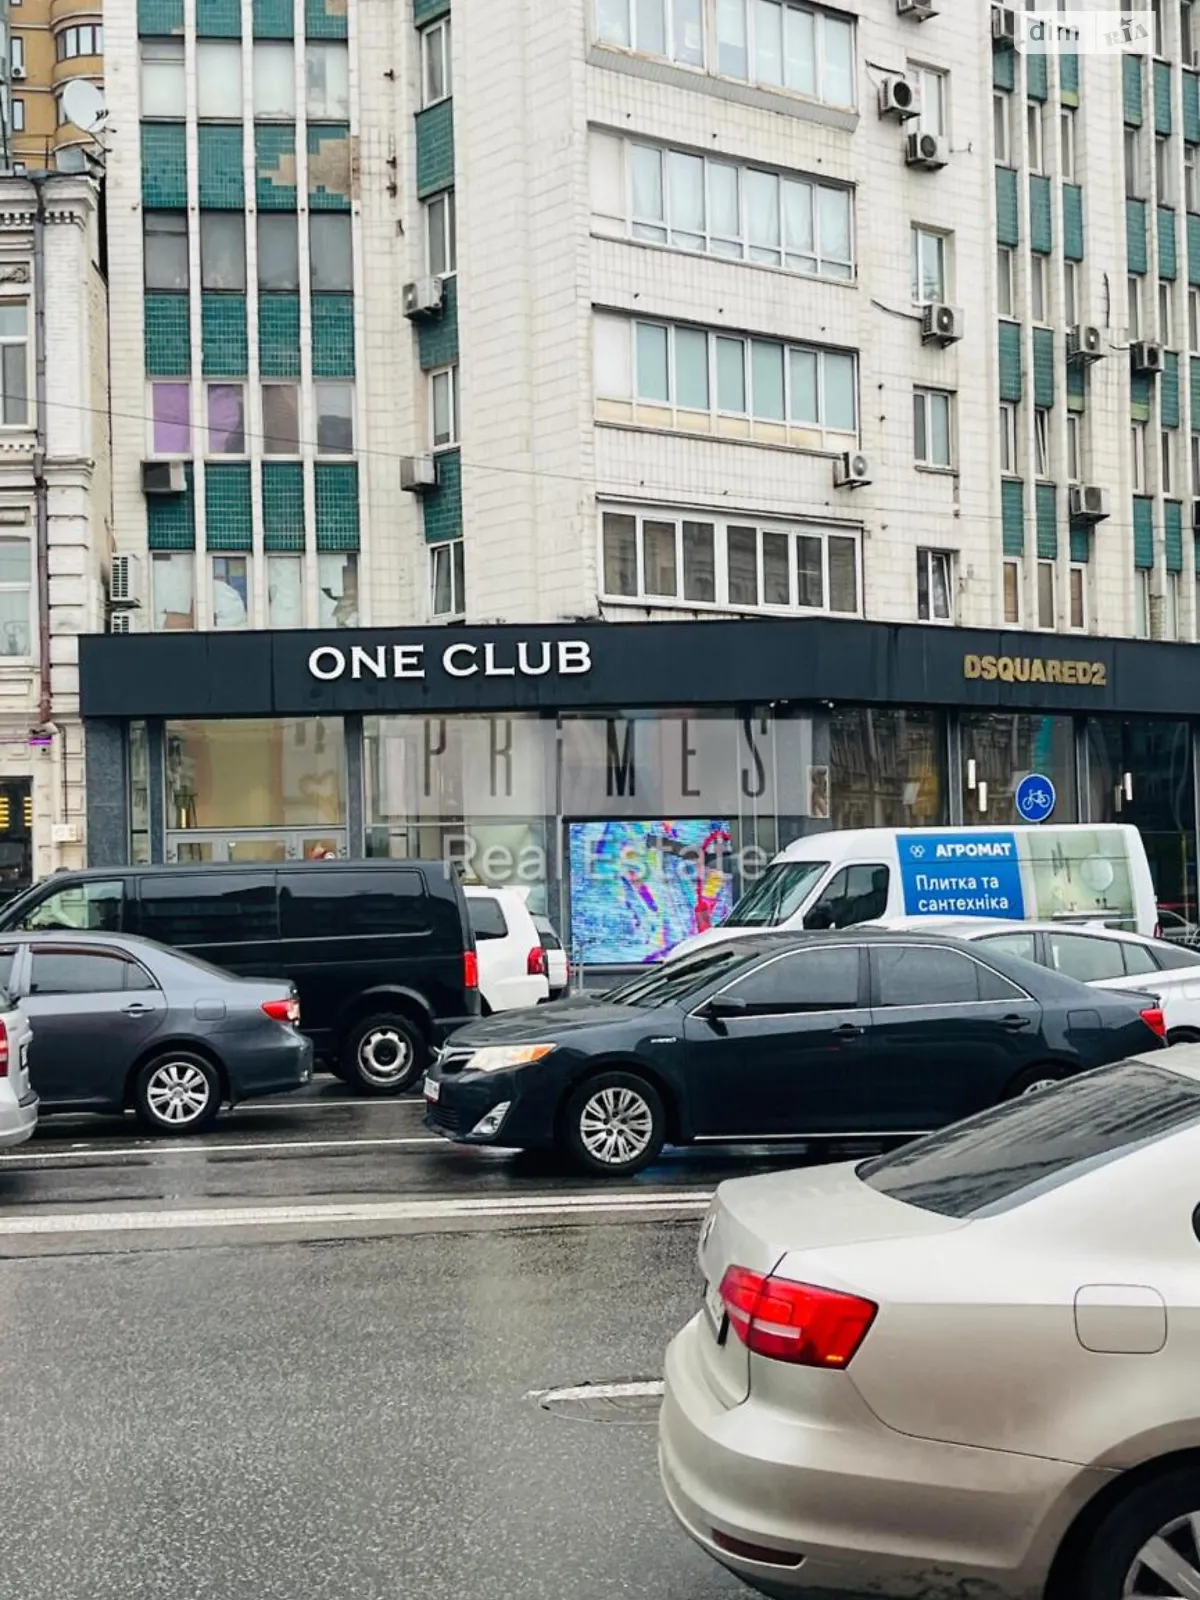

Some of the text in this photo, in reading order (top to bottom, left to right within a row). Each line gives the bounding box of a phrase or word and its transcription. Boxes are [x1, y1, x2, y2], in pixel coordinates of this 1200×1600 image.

[308, 640, 592, 680] ONE CLUB
[964, 654, 1107, 685] DSQUARED2
[936, 843, 1011, 857] АГРОМАТ
[916, 874, 999, 891] Плитка та
[918, 893, 1009, 912] сантехніка
